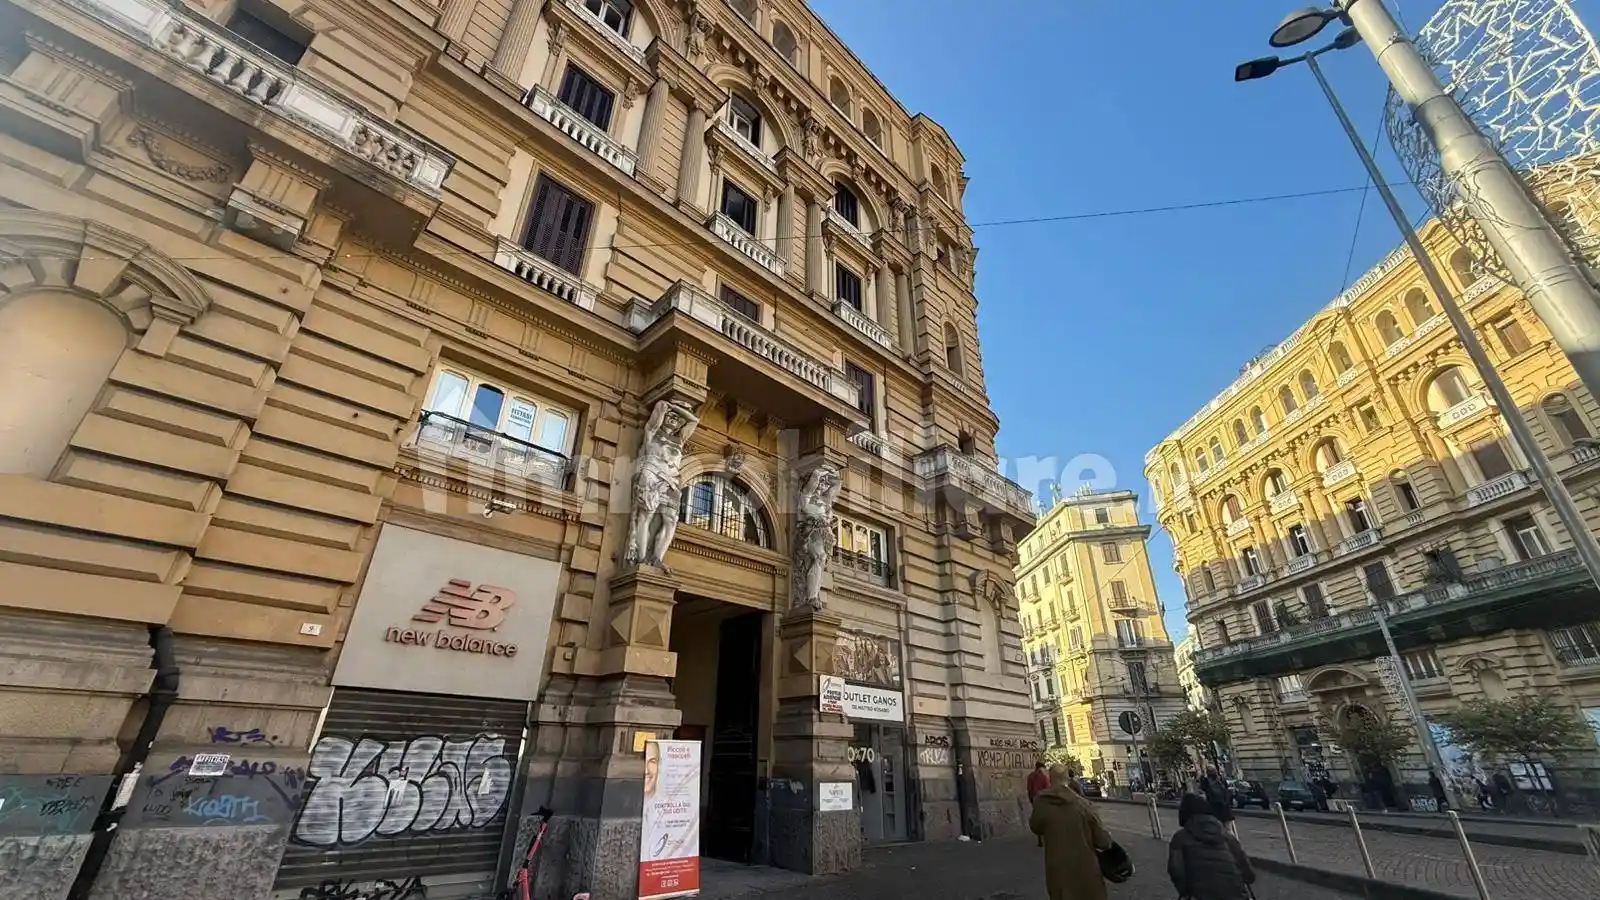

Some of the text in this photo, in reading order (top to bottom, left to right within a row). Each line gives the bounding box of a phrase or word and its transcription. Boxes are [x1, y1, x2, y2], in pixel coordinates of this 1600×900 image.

[384, 626, 518, 657] new balance
[843, 691, 871, 704] OUTLET
[872, 695, 897, 707] GANOS
